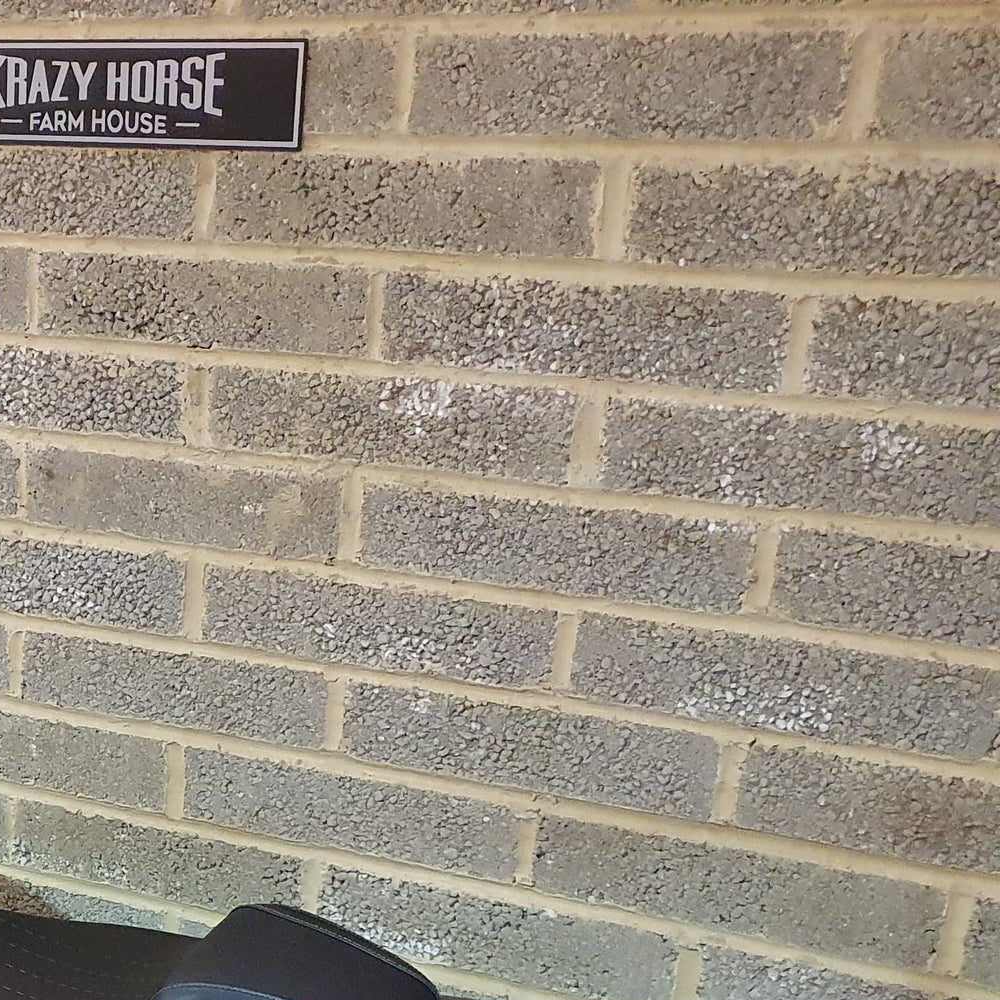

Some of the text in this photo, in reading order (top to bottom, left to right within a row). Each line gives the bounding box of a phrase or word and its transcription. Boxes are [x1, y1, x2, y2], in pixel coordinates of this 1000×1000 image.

[105, 52, 226, 117] HORSE
[29, 109, 167, 134] FARM HOUSE
